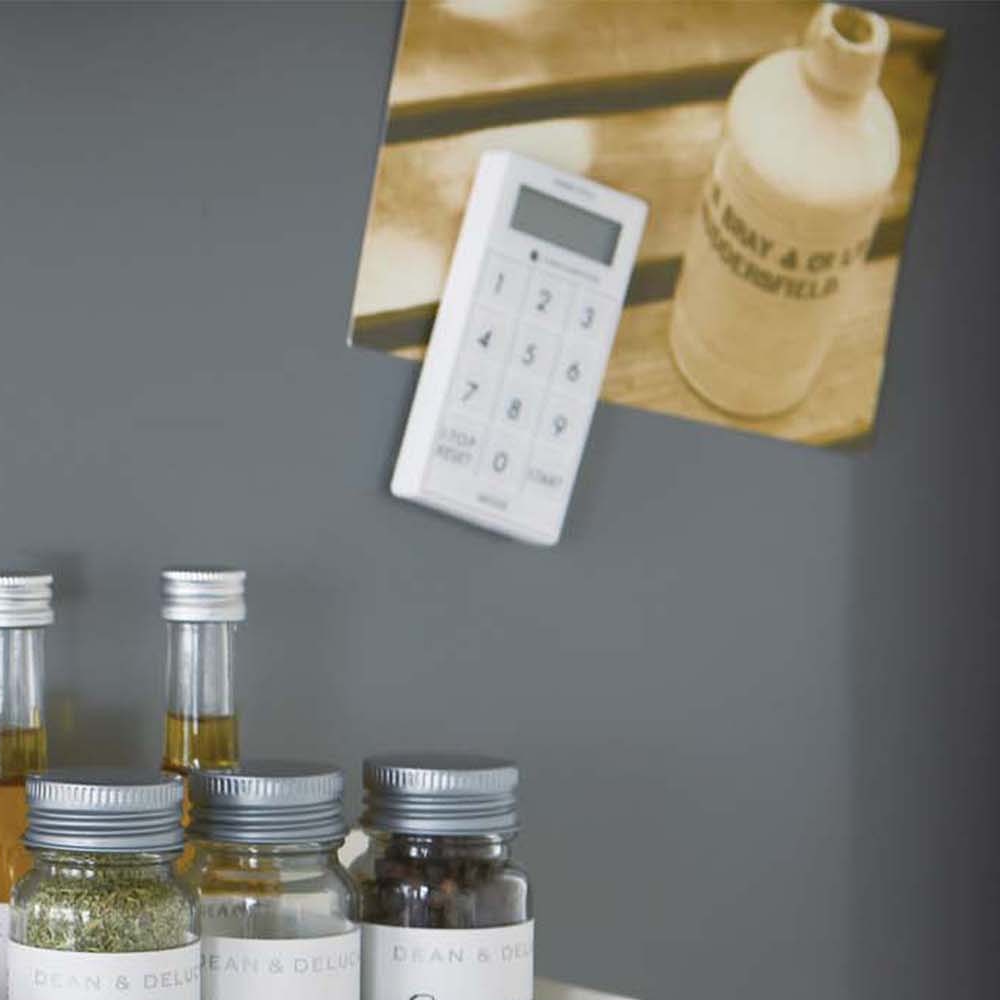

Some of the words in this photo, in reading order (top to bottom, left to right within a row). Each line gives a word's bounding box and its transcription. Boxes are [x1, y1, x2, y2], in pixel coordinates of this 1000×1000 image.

[495, 271, 505, 293] 1
[536, 289, 553, 314] 2
[580, 307, 596, 330] 3
[476, 328, 494, 350] 4
[521, 344, 537, 366] 5
[566, 361, 581, 383] 6
[461, 383, 479, 403] 7
[506, 399, 522, 421] 8
[552, 416, 569, 438] 9
[492, 451, 509, 474] 0
[393, 945, 464, 964] DEAN
[476, 947, 490, 963] &
[268, 958, 285, 975] &
[34, 969, 101, 992] DEAN
[114, 975, 130, 991] &
